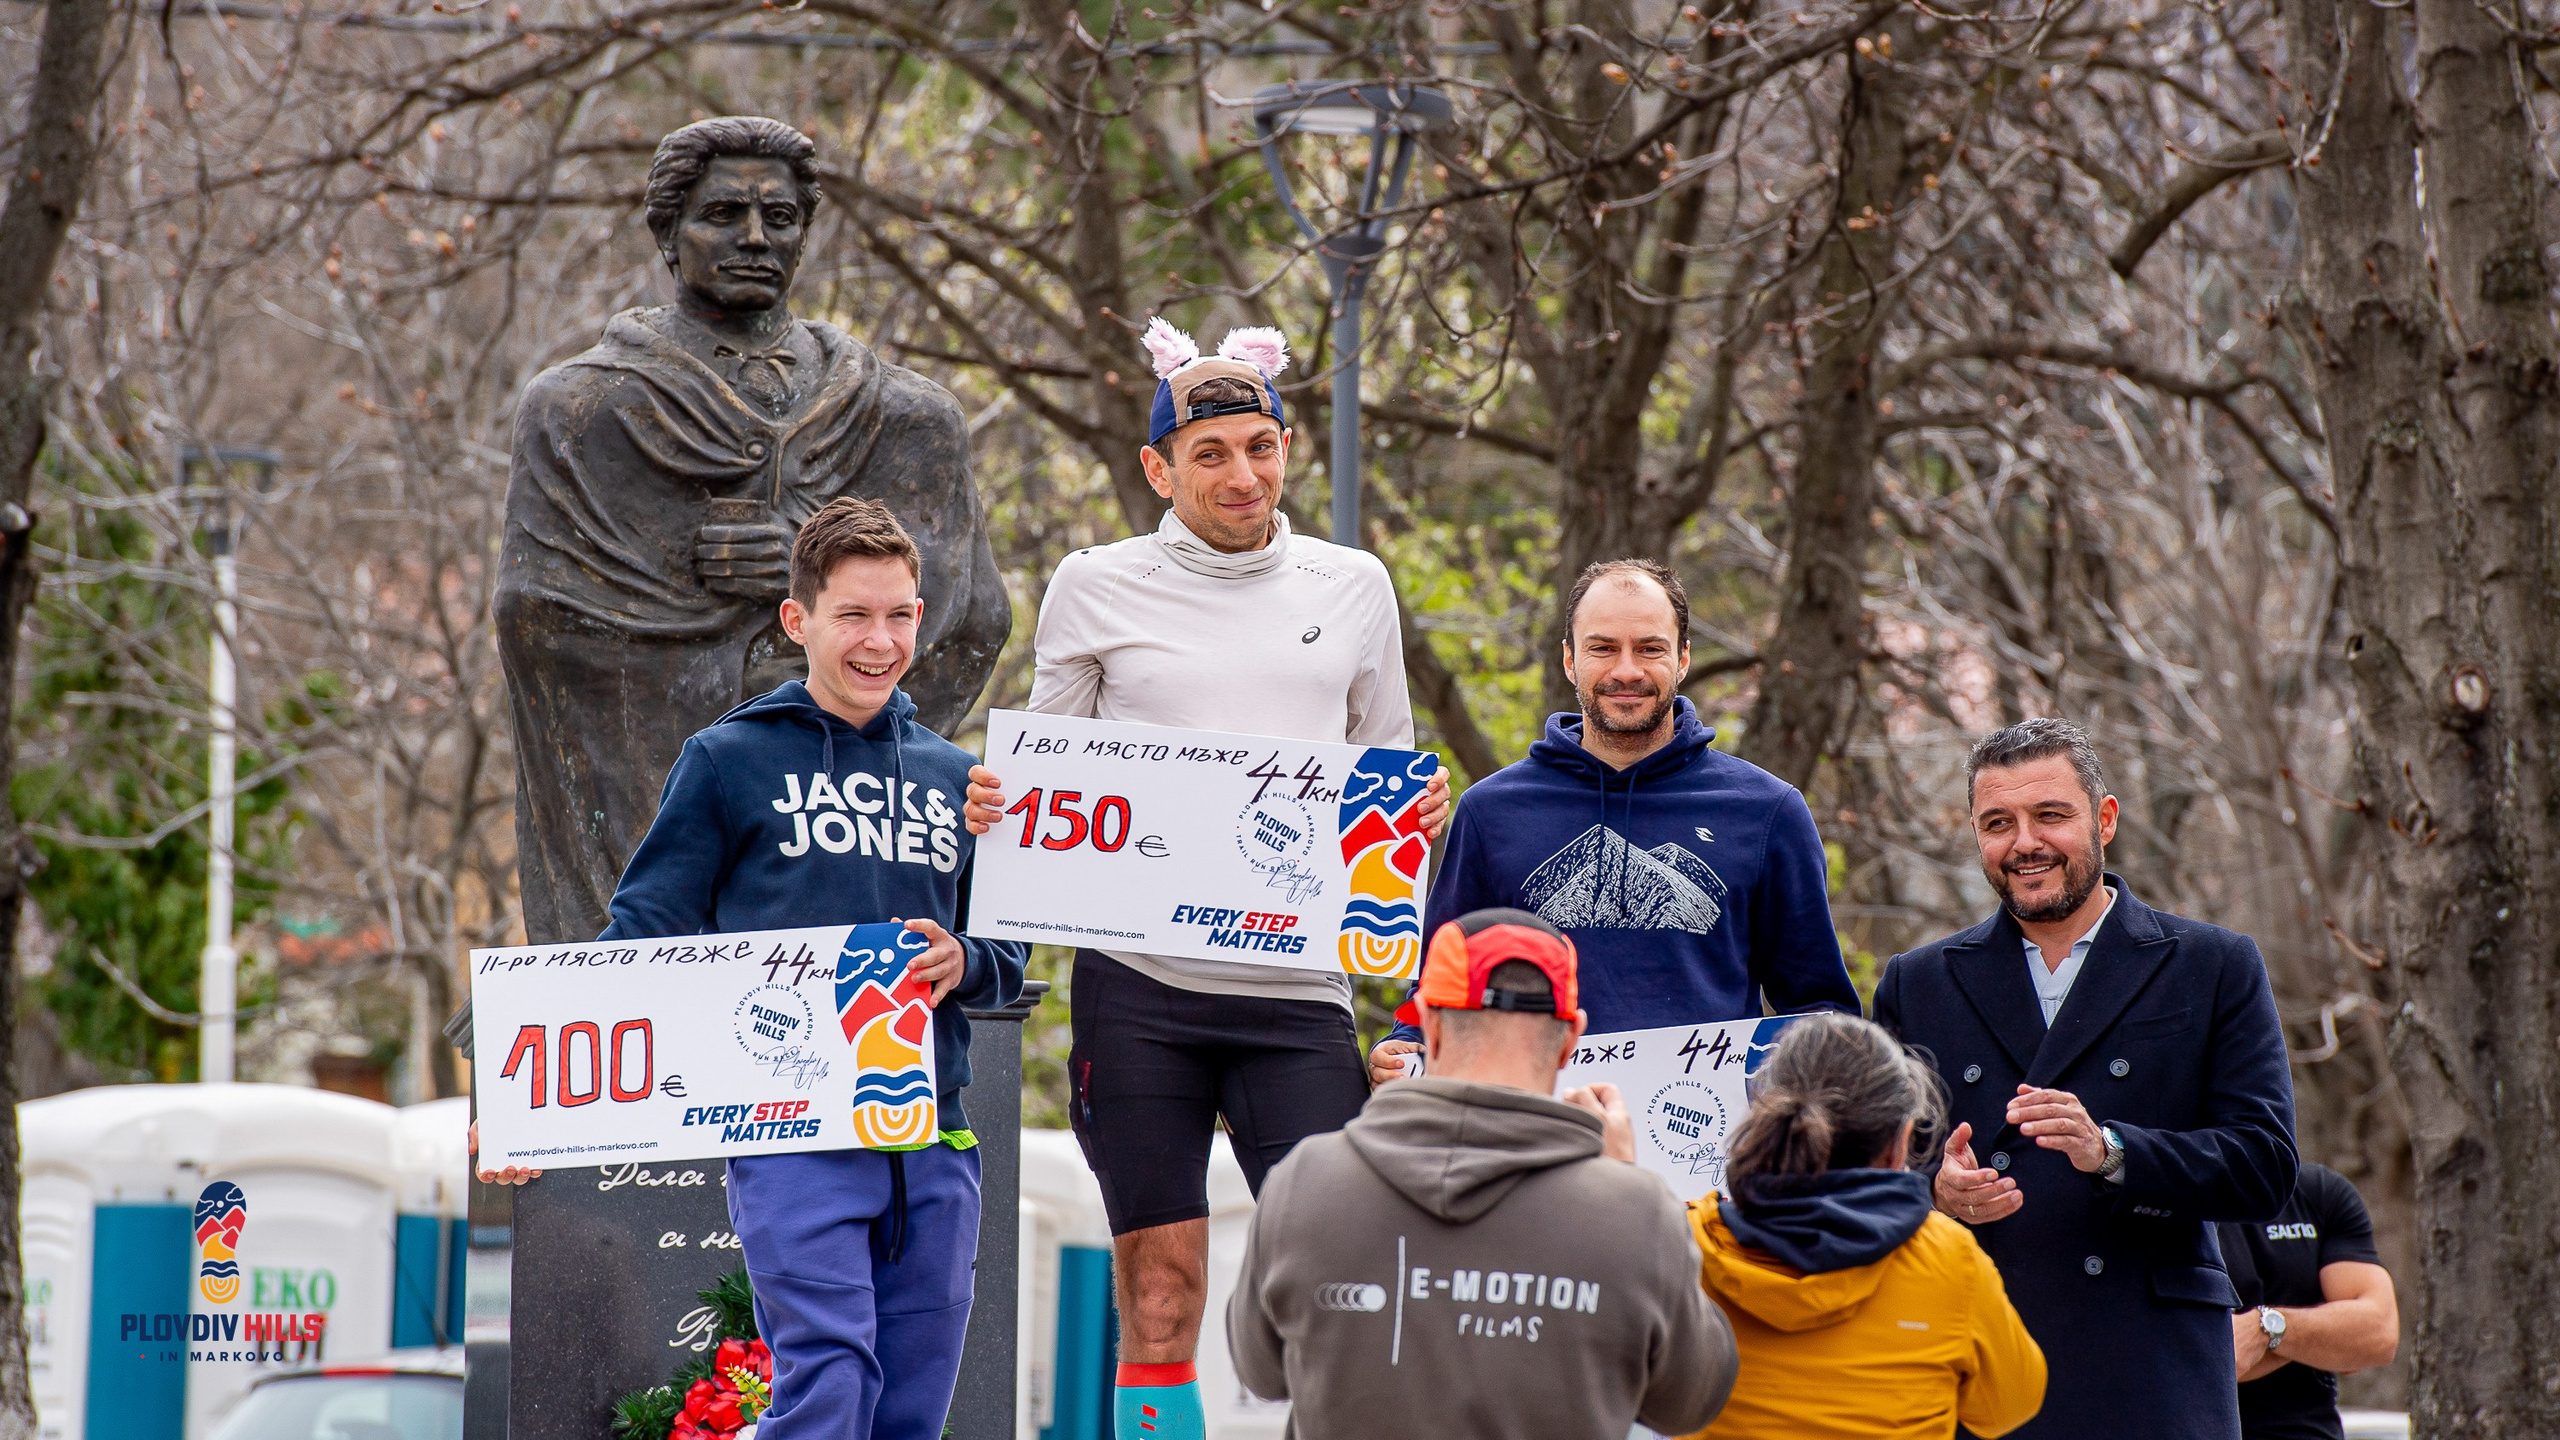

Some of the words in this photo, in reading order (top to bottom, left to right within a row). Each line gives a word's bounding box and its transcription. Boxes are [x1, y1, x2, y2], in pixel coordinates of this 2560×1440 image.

[1272, 792, 1297, 803] HILLS
[1298, 803, 1307, 812] IN
[1253, 810, 1302, 843] PLOVDIV
[1302, 814, 1315, 856] MARKOVO
[778, 811, 959, 873] JONES
[1236, 834, 1248, 858] TRAIL
[1250, 858, 1267, 870] RUN
[1253, 828, 1287, 853] HILLS
[997, 919, 1145, 940] www.plovdiv-hills-in-markovo.com
[1171, 904, 1245, 927] EVERY
[1241, 911, 1299, 933] STEP
[1206, 928, 1307, 954] MATTERS
[734, 986, 762, 1016] PLOVDIV
[765, 983, 790, 992] HILLS
[793, 990, 802, 999] IN
[802, 1000, 814, 1041] MARKOVO
[750, 1004, 801, 1030] PLOVDIV
[753, 1021, 787, 1042] HILLS
[734, 1031, 750, 1052] TRAIL
[752, 1052, 770, 1061] RUN
[682, 1103, 755, 1127] EVERY
[752, 1100, 810, 1122] STEP
[1647, 1083, 1673, 1115] PLOVDIV
[1676, 1080, 1701, 1088] HILLS
[1704, 1086, 1713, 1095] IN
[1714, 1096, 1727, 1138] MARKOVO
[1662, 1101, 1713, 1127] PLOVDIV
[720, 1118, 822, 1144] MATTERS
[1666, 1118, 1701, 1139] HILLS
[507, 1140, 659, 1158] www.plovdiv-hills-in-markovo.com
[1648, 1129, 1665, 1151] TRAIL
[1668, 1150, 1685, 1159] RUN
[1410, 1267, 1601, 1315] E-MOTION
[1458, 1313, 1544, 1343] FILMS
